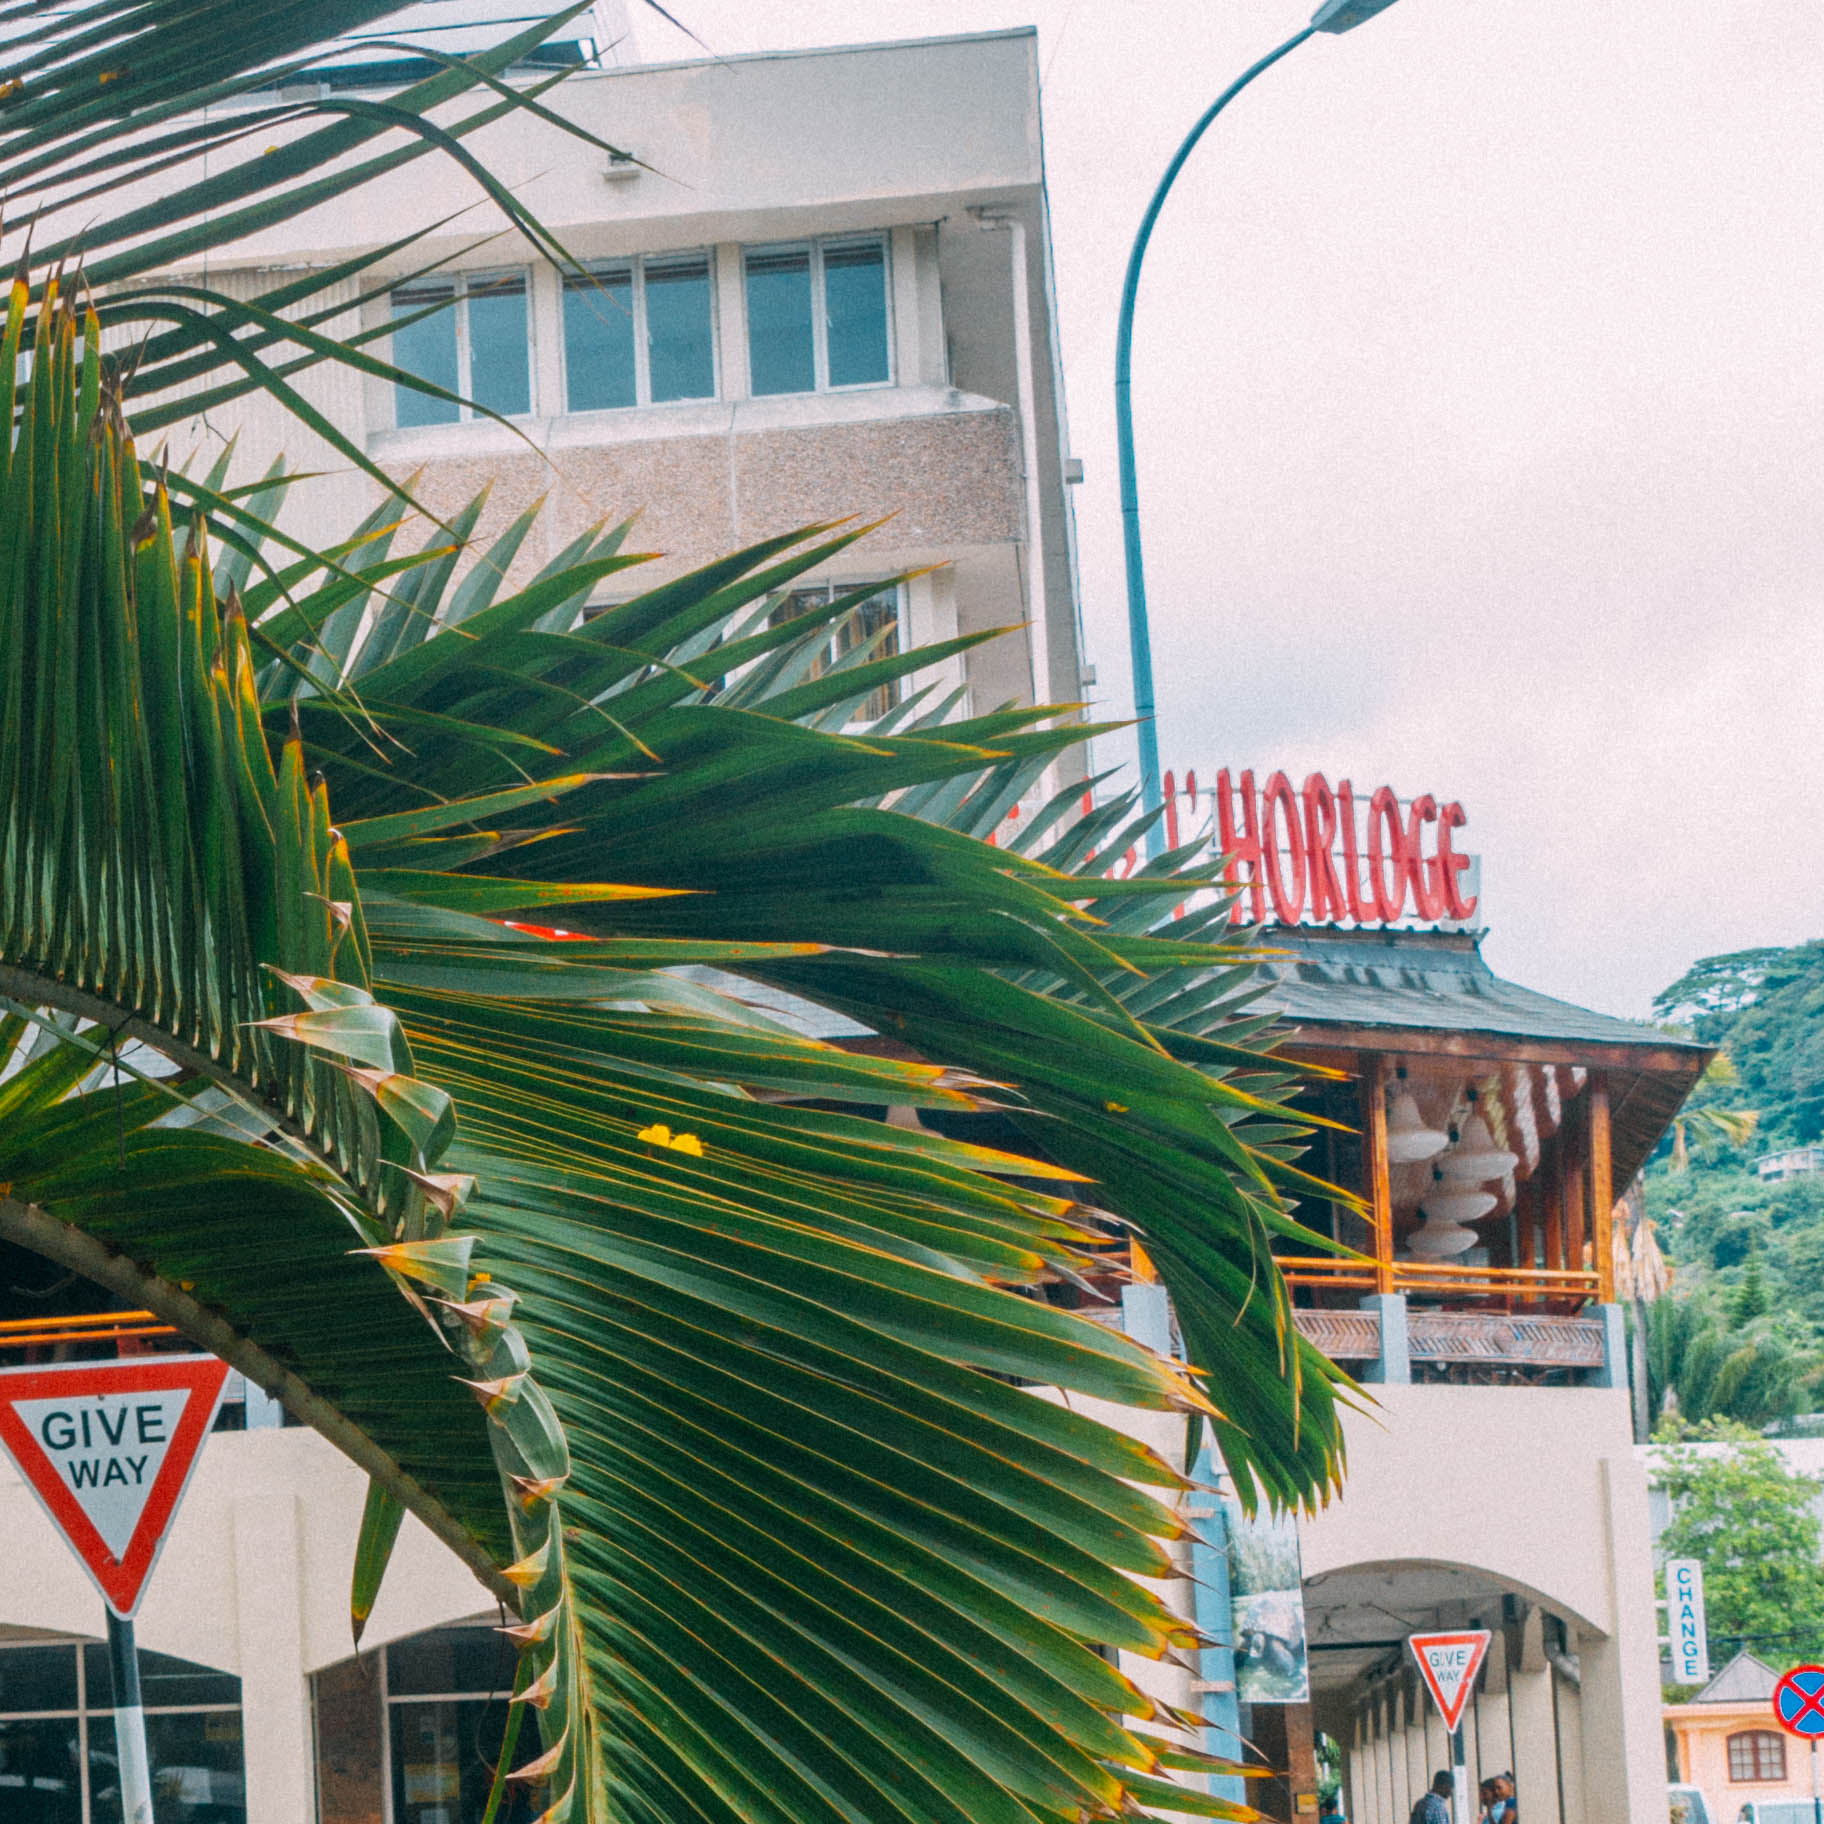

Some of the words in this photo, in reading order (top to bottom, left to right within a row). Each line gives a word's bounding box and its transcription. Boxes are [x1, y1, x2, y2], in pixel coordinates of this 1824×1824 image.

[41, 1405, 166, 1450] GIVE
[68, 1455, 149, 1489] WAY
[1677, 1567, 1698, 1676] CHANGE
[1429, 1650, 1466, 1668] GIVE
[1438, 1670, 1460, 1682] WAY
